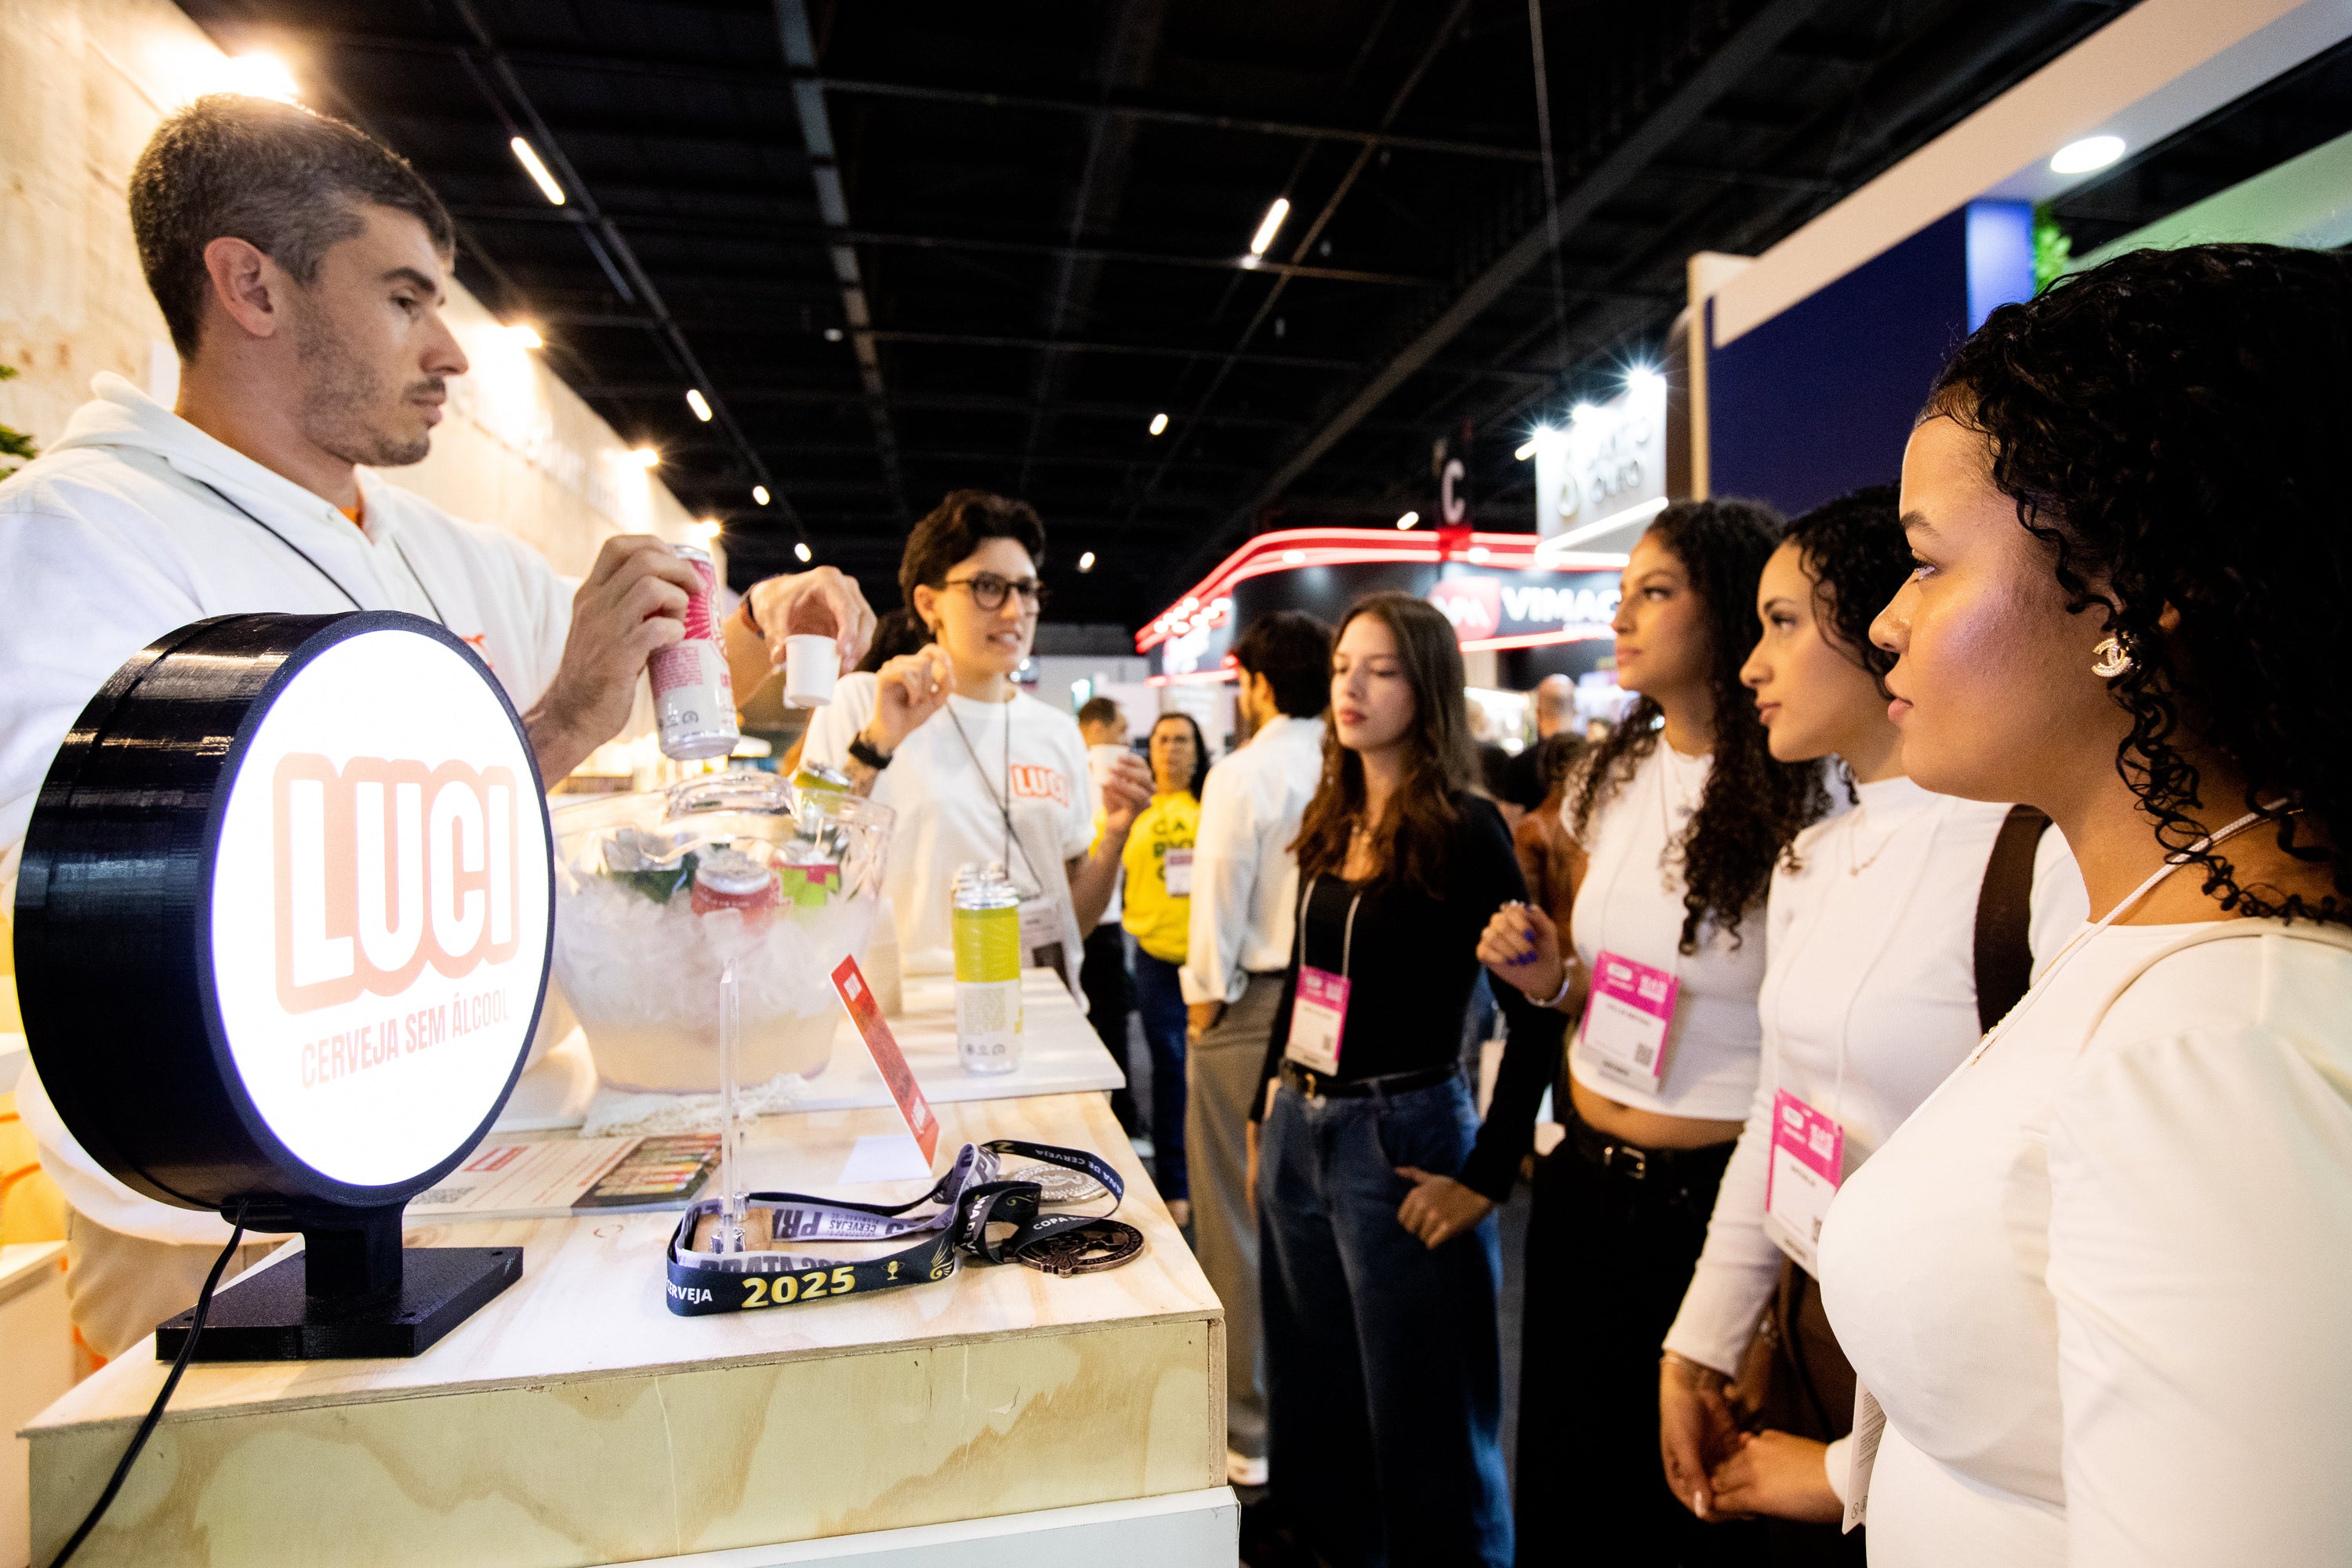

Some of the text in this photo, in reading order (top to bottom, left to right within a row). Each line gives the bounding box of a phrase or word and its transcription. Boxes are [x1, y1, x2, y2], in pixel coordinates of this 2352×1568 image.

[274, 754, 518, 1012] LUCI
[302, 988, 510, 1090] CERVEJA SEM ÁLCOOL
[829, 1219, 877, 1233] CERVEJAS
[1033, 1216, 1069, 1231] COPA
[741, 1265, 855, 1309] 2025
